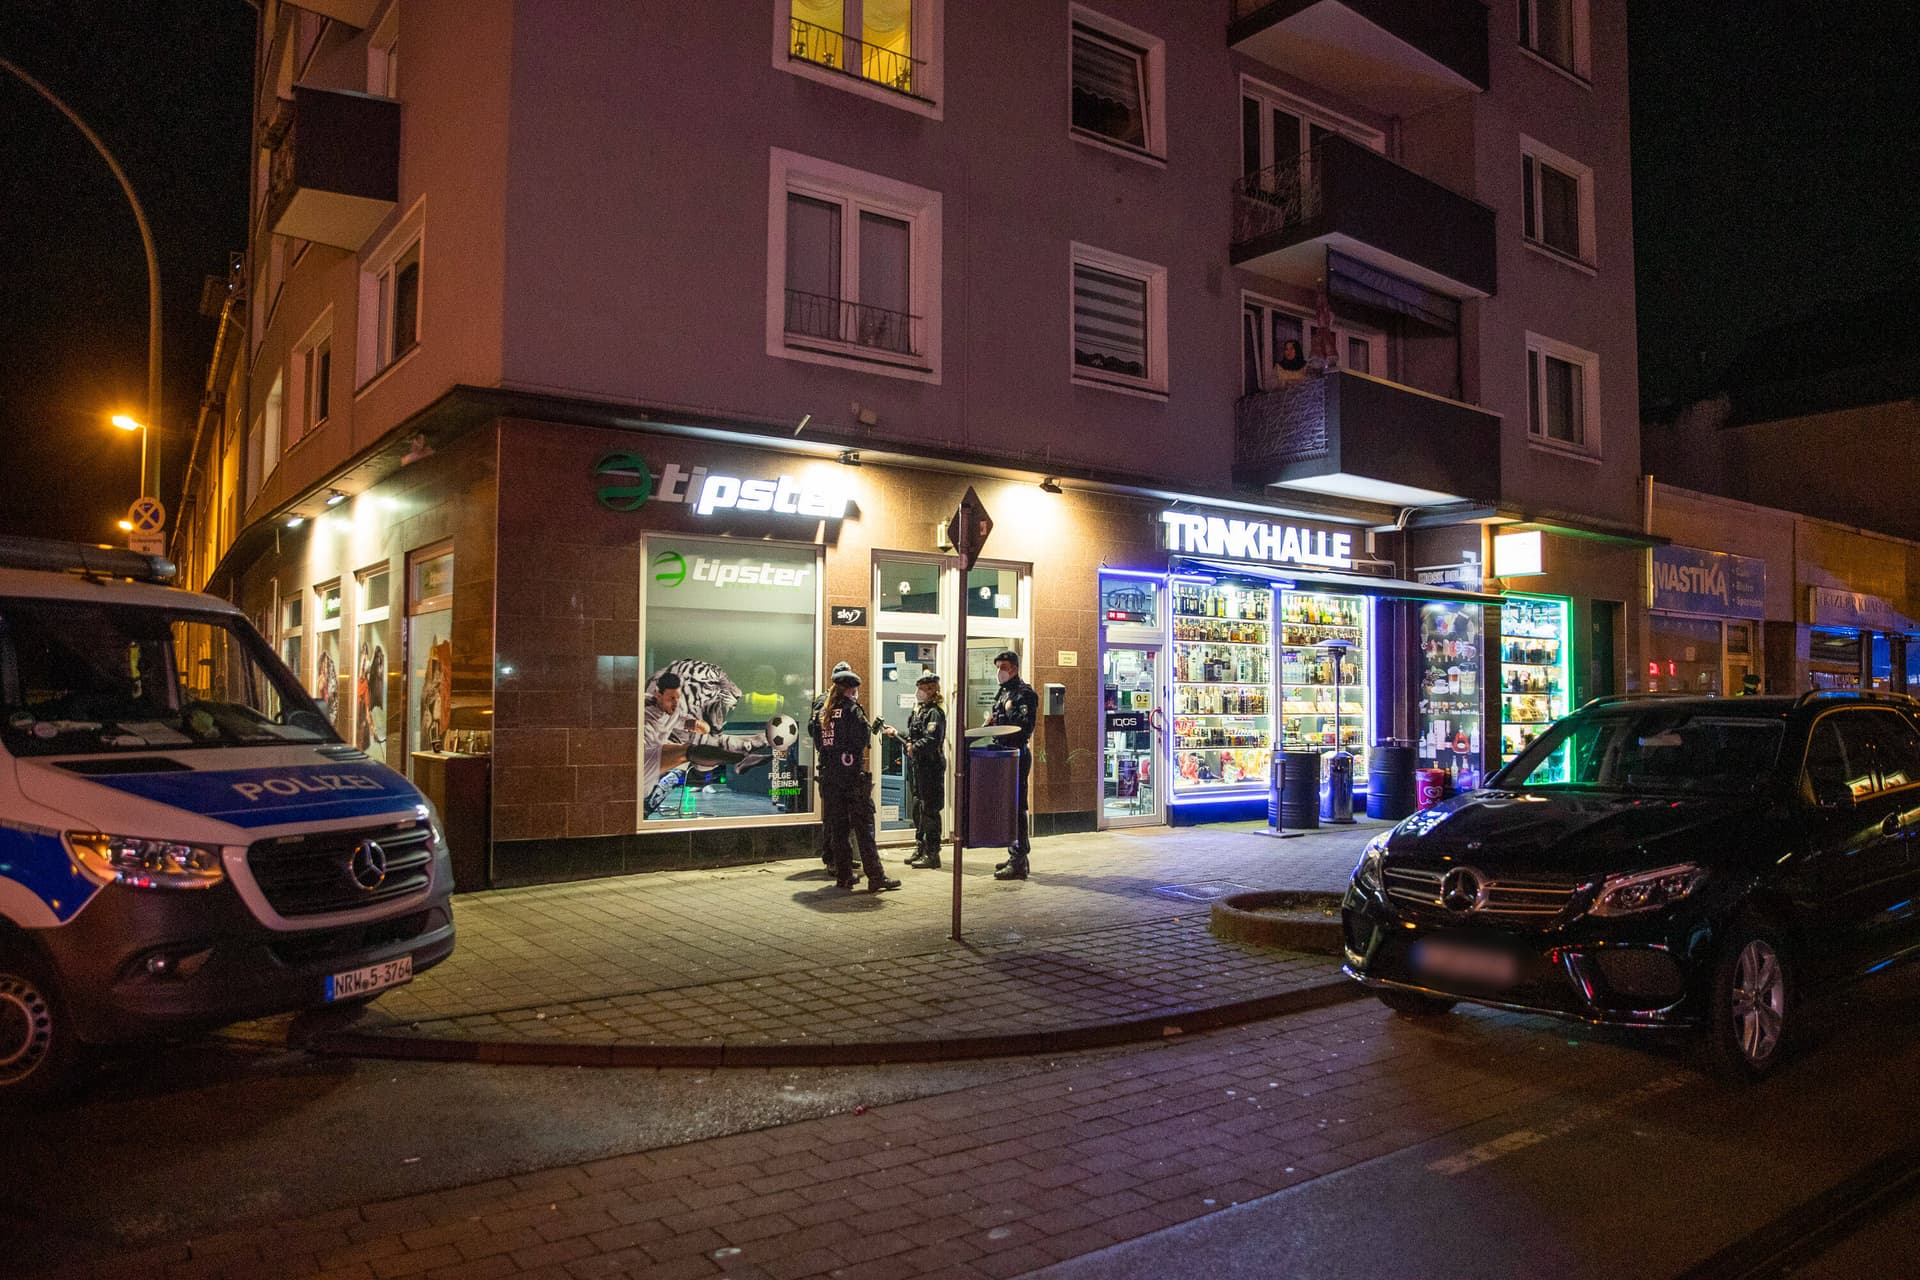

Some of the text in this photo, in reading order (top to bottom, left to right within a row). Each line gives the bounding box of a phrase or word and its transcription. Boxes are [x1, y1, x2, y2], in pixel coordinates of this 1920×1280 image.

[1162, 510, 1352, 569] TRINKHALLE
[692, 557, 810, 588] tipster
[837, 608, 860, 624] sky
[1112, 717, 1138, 727] IQOS
[231, 775, 385, 801] POLIZEI
[335, 972, 362, 996] NRW
